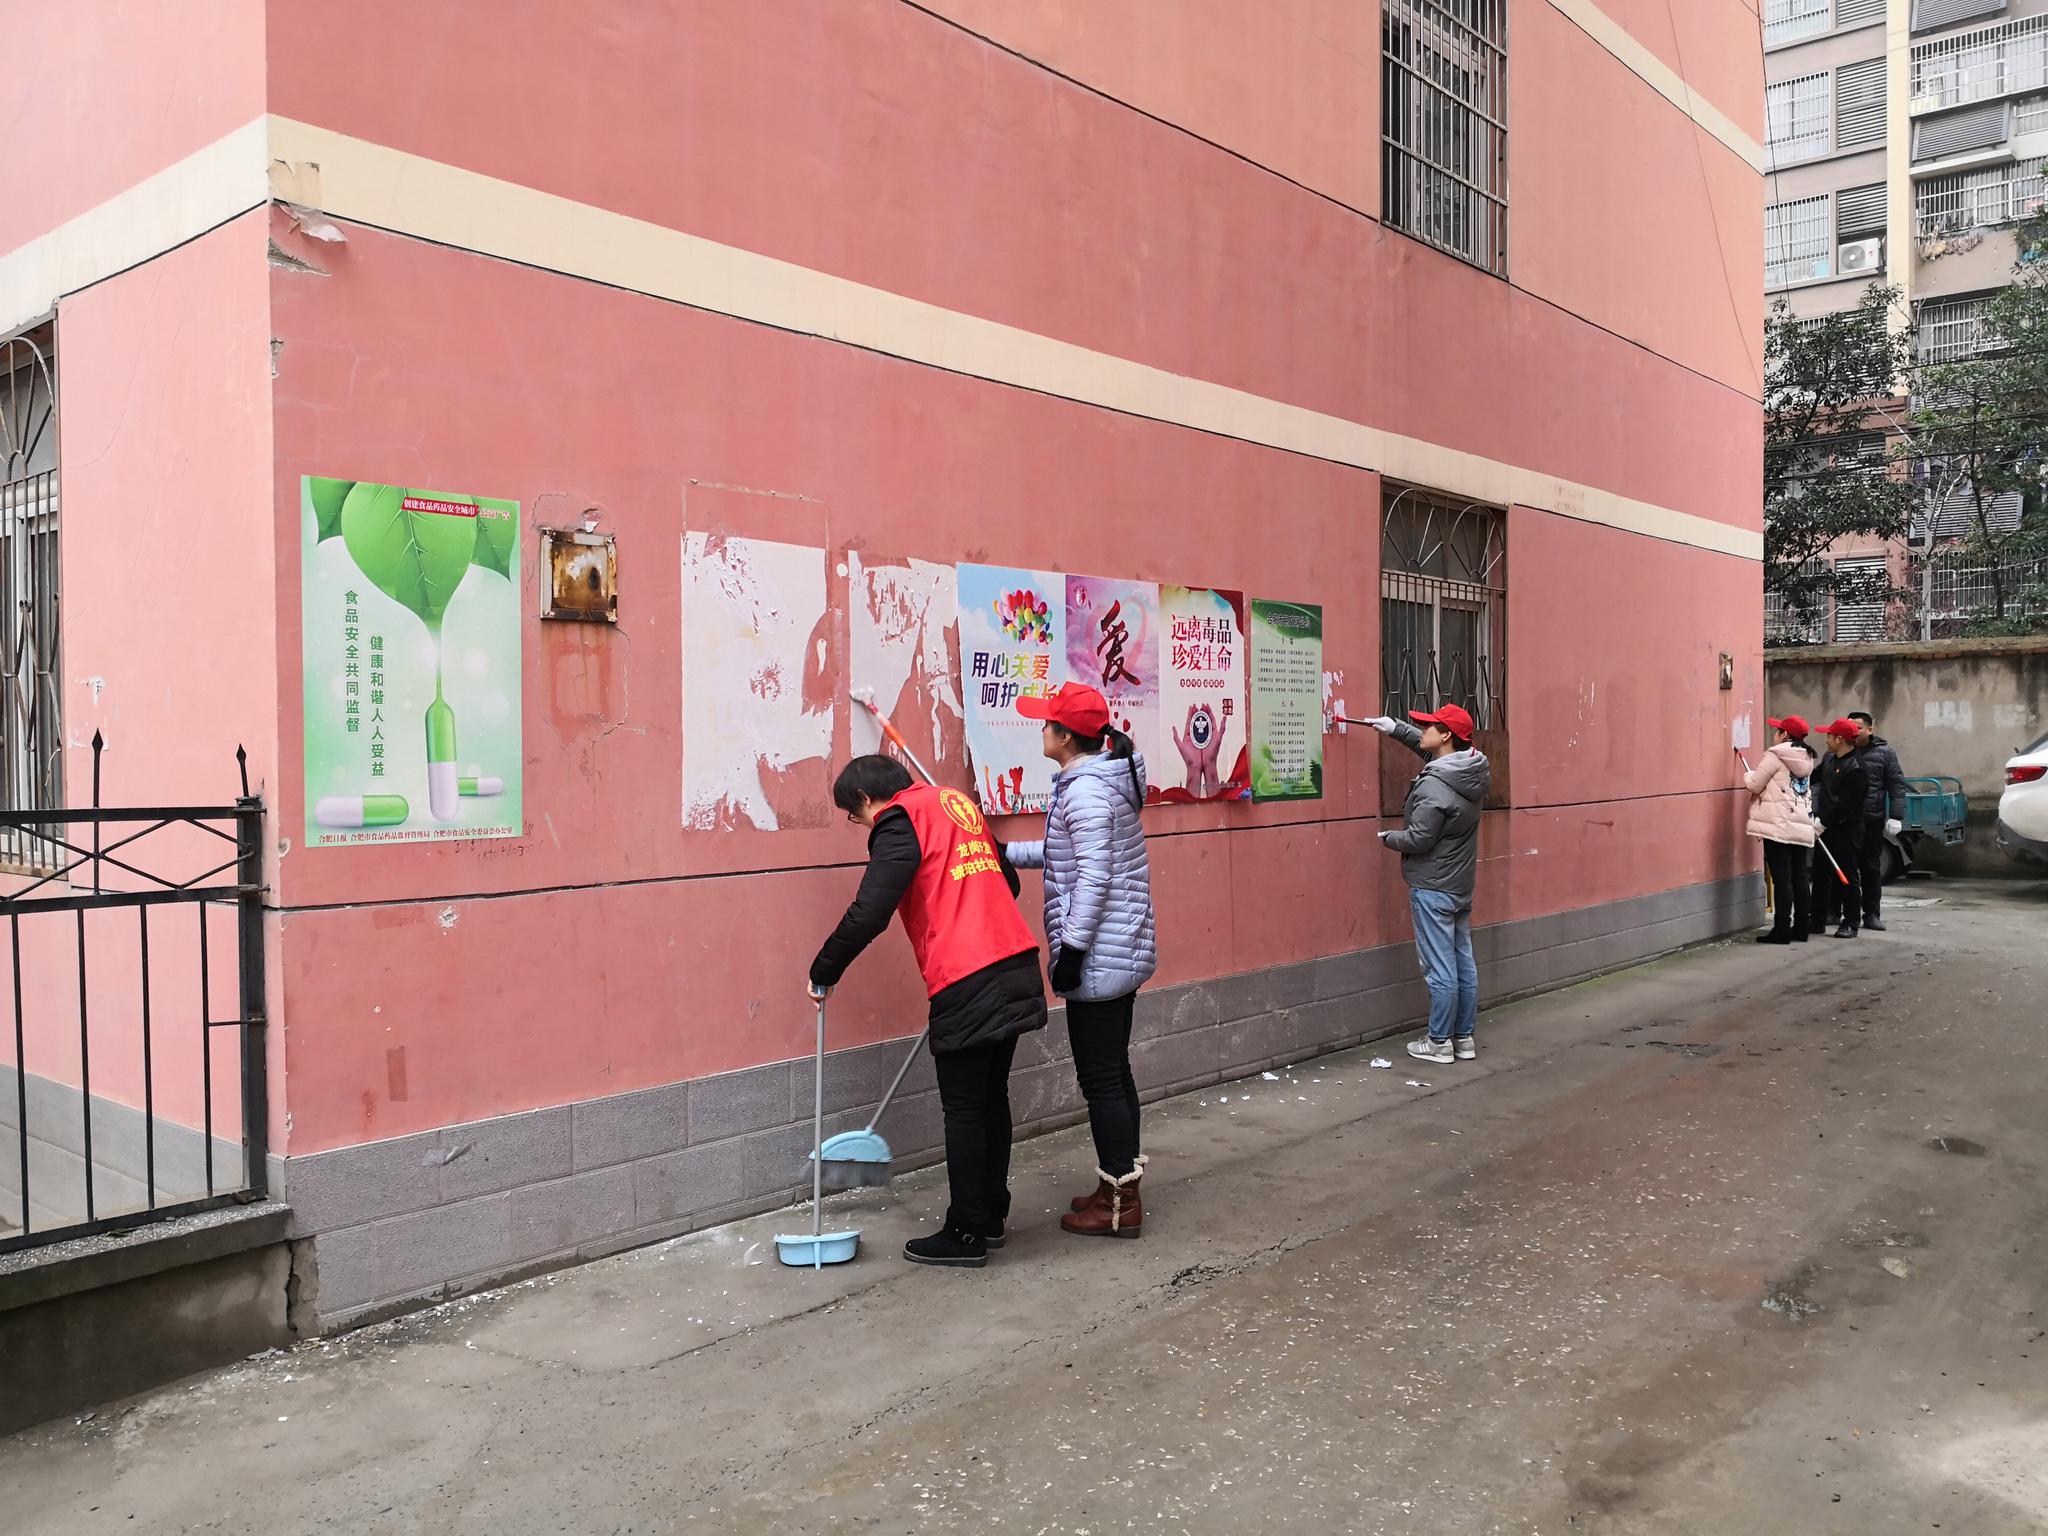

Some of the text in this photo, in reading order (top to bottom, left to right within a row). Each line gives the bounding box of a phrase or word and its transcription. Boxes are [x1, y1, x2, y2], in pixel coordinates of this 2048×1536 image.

[403, 498, 476, 516] 创建食品药品安全城市
[1096, 599, 1142, 689] 爱
[1171, 614, 1232, 645] 远离毒品
[344, 590, 360, 733] 食品安全共同监督
[971, 651, 1050, 681] 用心关爱
[1171, 644, 1232, 672] 珍爱生命
[369, 635, 385, 778] 健康和谐人人受益
